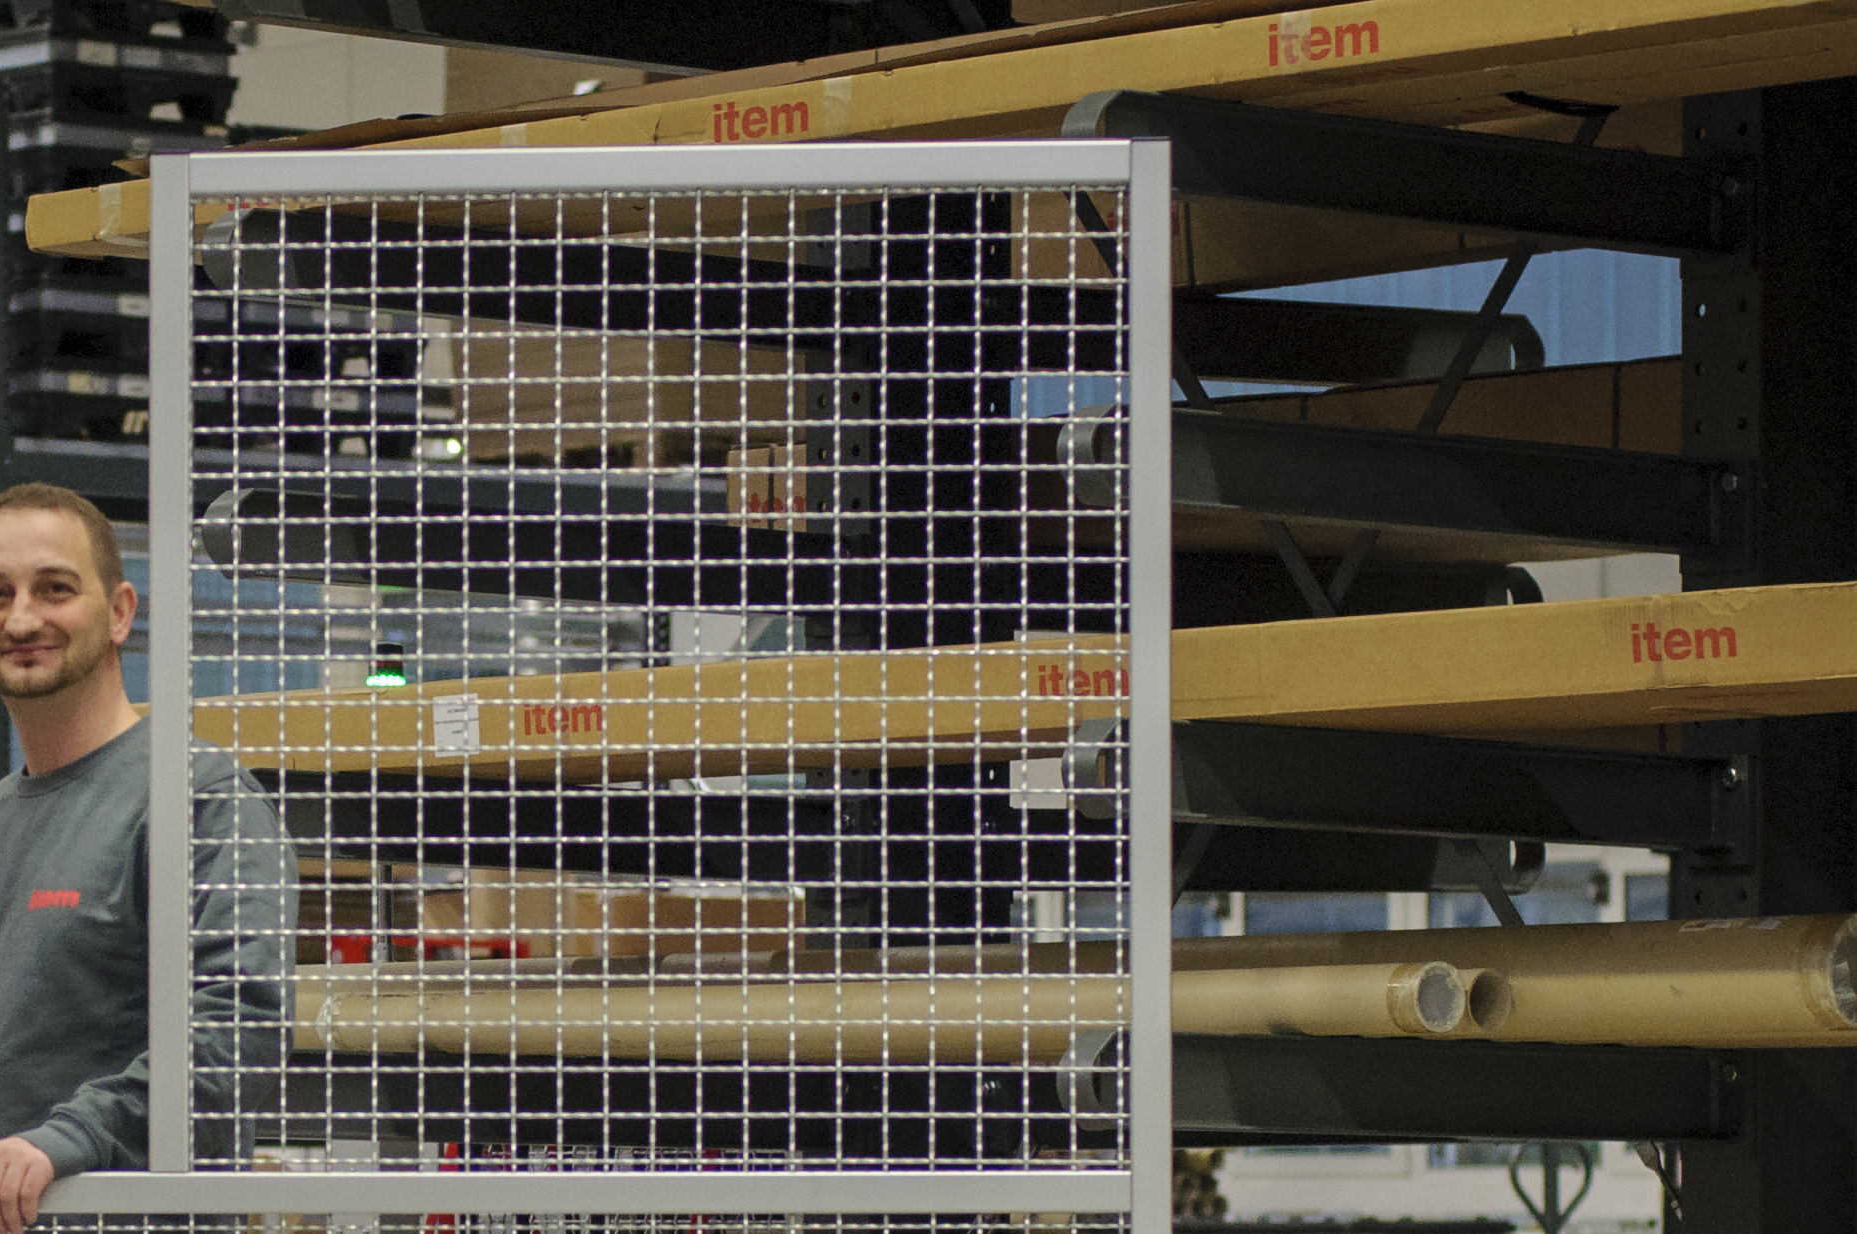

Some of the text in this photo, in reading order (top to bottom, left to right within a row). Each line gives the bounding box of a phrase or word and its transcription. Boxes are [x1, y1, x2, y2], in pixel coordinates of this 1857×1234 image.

[1268, 20, 1379, 67] item
[713, 101, 809, 143] item
[1631, 622, 1737, 664] item
[1038, 664, 1130, 698] item
[523, 703, 603, 736] item
